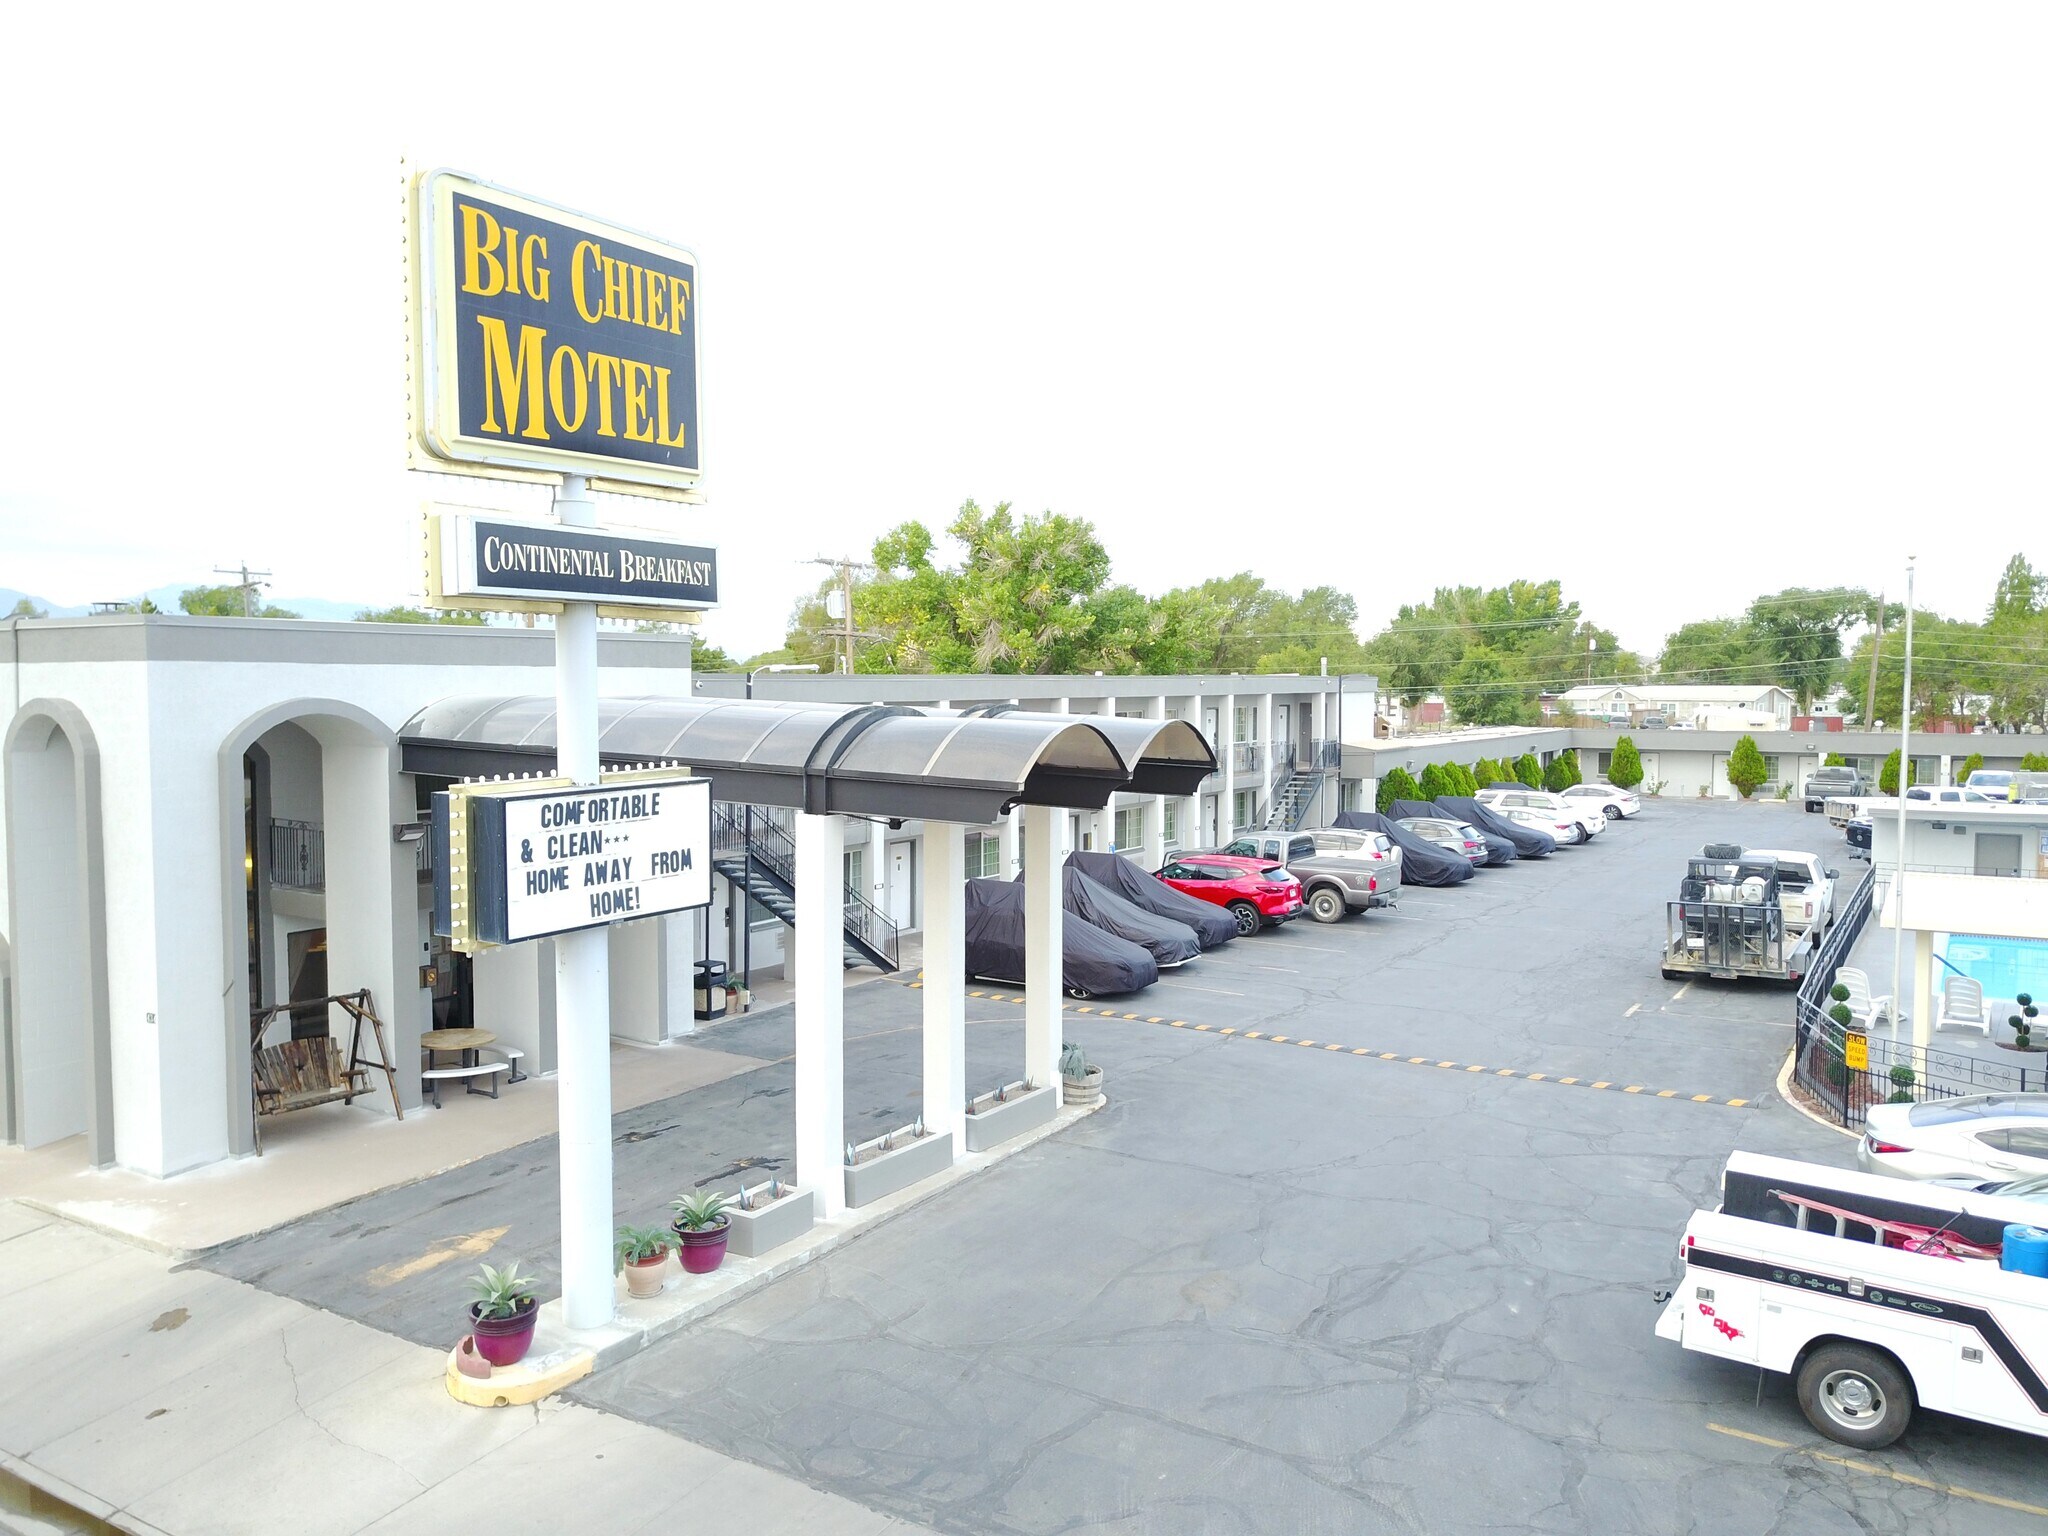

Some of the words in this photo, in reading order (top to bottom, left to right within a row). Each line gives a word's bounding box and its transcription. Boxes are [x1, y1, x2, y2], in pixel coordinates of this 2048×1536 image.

[459, 204, 550, 303] BIG
[571, 240, 690, 335] CHIEF
[477, 315, 685, 448] MOTEL
[484, 536, 614, 578] CONTINENTAL
[619, 550, 711, 586] BREAKFAST
[541, 792, 660, 828] COMFORTABLE
[521, 838, 533, 863] &
[526, 866, 569, 896] HOME
[584, 857, 632, 886] AWAY
[651, 848, 692, 876] FROM
[590, 886, 640, 918] HOME!
[1848, 1035, 1866, 1045] SLOW
[1849, 1046, 1866, 1055] SPEED
[1849, 1055, 1865, 1063] BUMP
